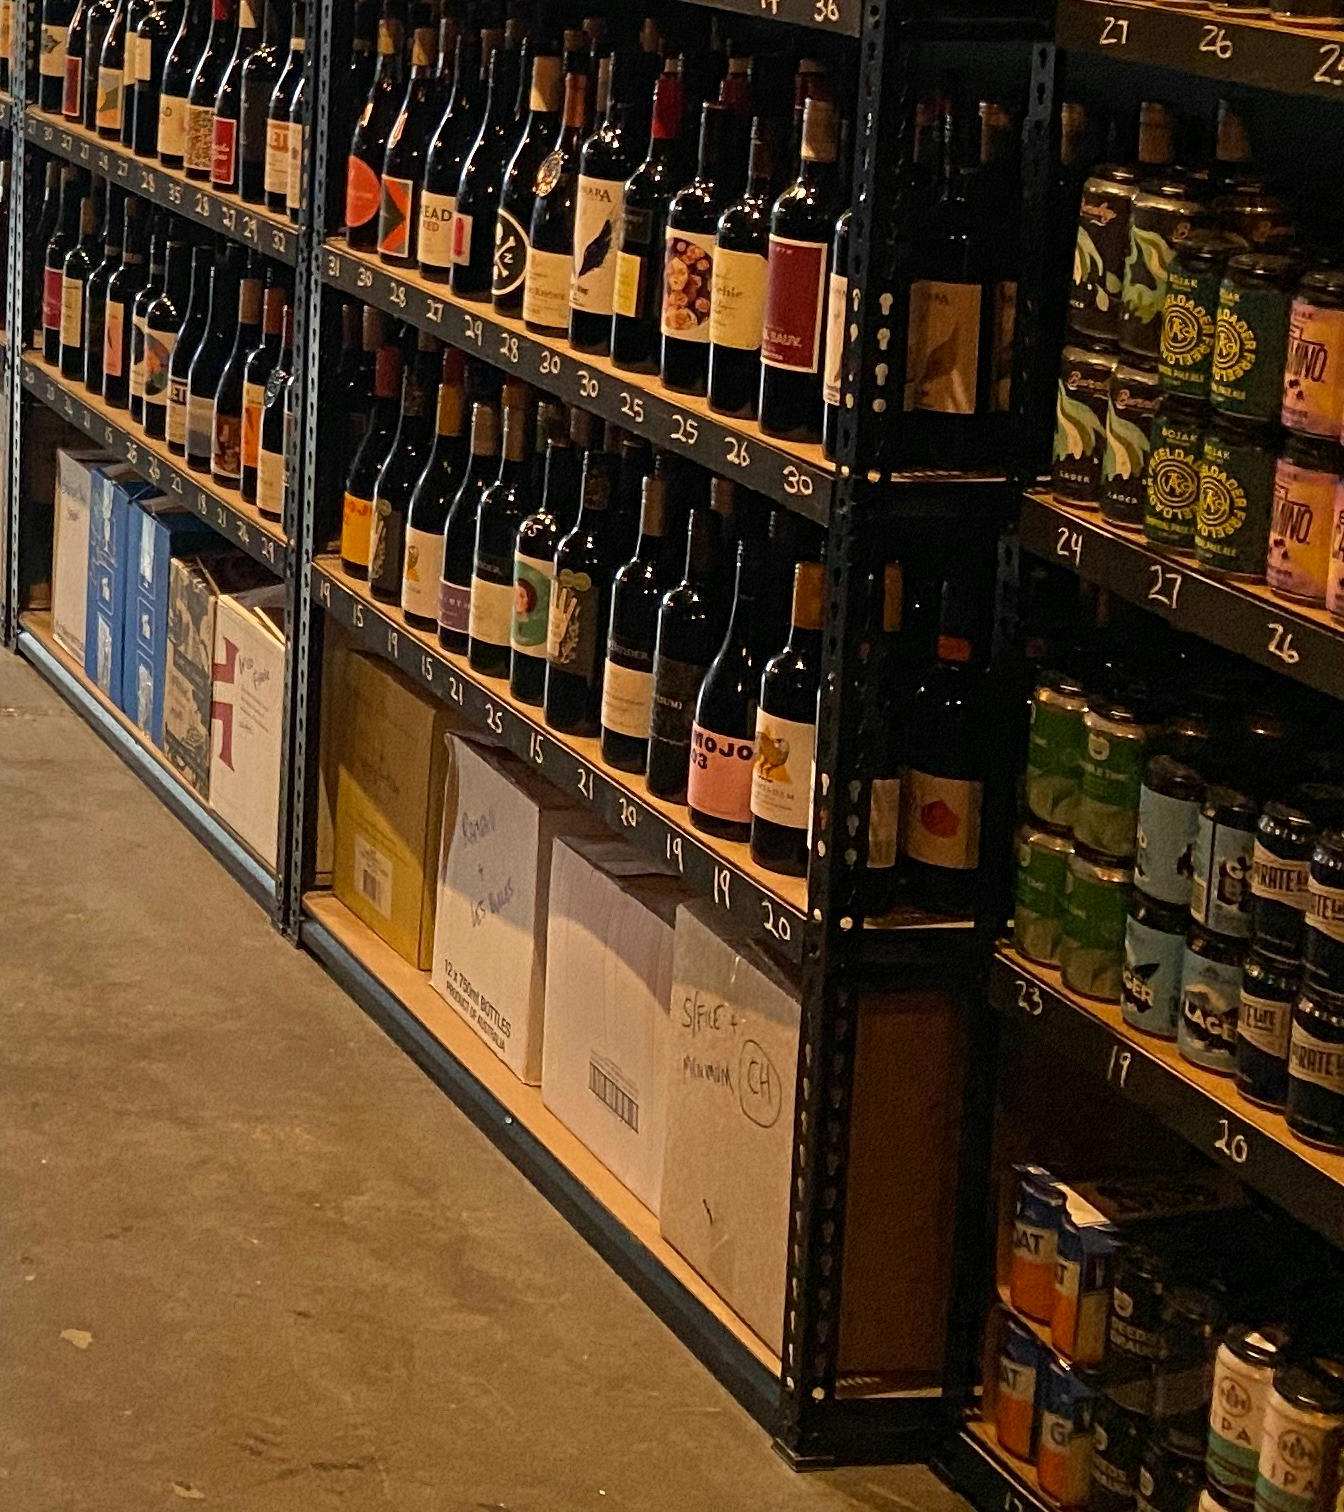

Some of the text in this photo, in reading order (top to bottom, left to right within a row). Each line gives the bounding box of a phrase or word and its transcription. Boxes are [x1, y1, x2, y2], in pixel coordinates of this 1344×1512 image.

[1099, 16, 1129, 45] 27
[1198, 24, 1234, 59] 26
[1313, 43, 1344, 86] 2
[390, 282, 407, 308] 28
[425, 299, 444, 324] 27
[464, 315, 483, 347] 29
[500, 333, 519, 363] 28
[539, 351, 561, 375] 30
[576, 370, 599, 398] 30
[619, 392, 644, 423] 25
[670, 414, 698, 445] 25
[724, 437, 751, 468] 26
[782, 465, 813, 496] 30
[1056, 527, 1083, 567] 24
[320, 581, 331, 608] 19
[1148, 564, 1182, 609] 27
[352, 605, 364, 627] 15
[388, 632, 398, 659] 19
[1267, 623, 1300, 664] 26
[421, 655, 433, 681] 15
[449, 677, 463, 705] 21
[484, 703, 503, 734] 25
[530, 732, 544, 764] 15
[693, 730, 753, 760] MOJO
[577, 768, 594, 800] 21
[619, 797, 637, 827] 20
[666, 833, 684, 872] 19
[714, 865, 731, 910] 19
[762, 899, 791, 941] 20
[444, 958, 454, 978] 12
[480, 994, 512, 1039] BOTTLES
[1015, 980, 1043, 1016] 23
[446, 980, 469, 1015] PRODUCT
[476, 1014, 506, 1053] AUSTRALIA
[1107, 1045, 1132, 1088] 19
[747, 1059, 771, 1106] CH
[1214, 1119, 1248, 1164] 20
